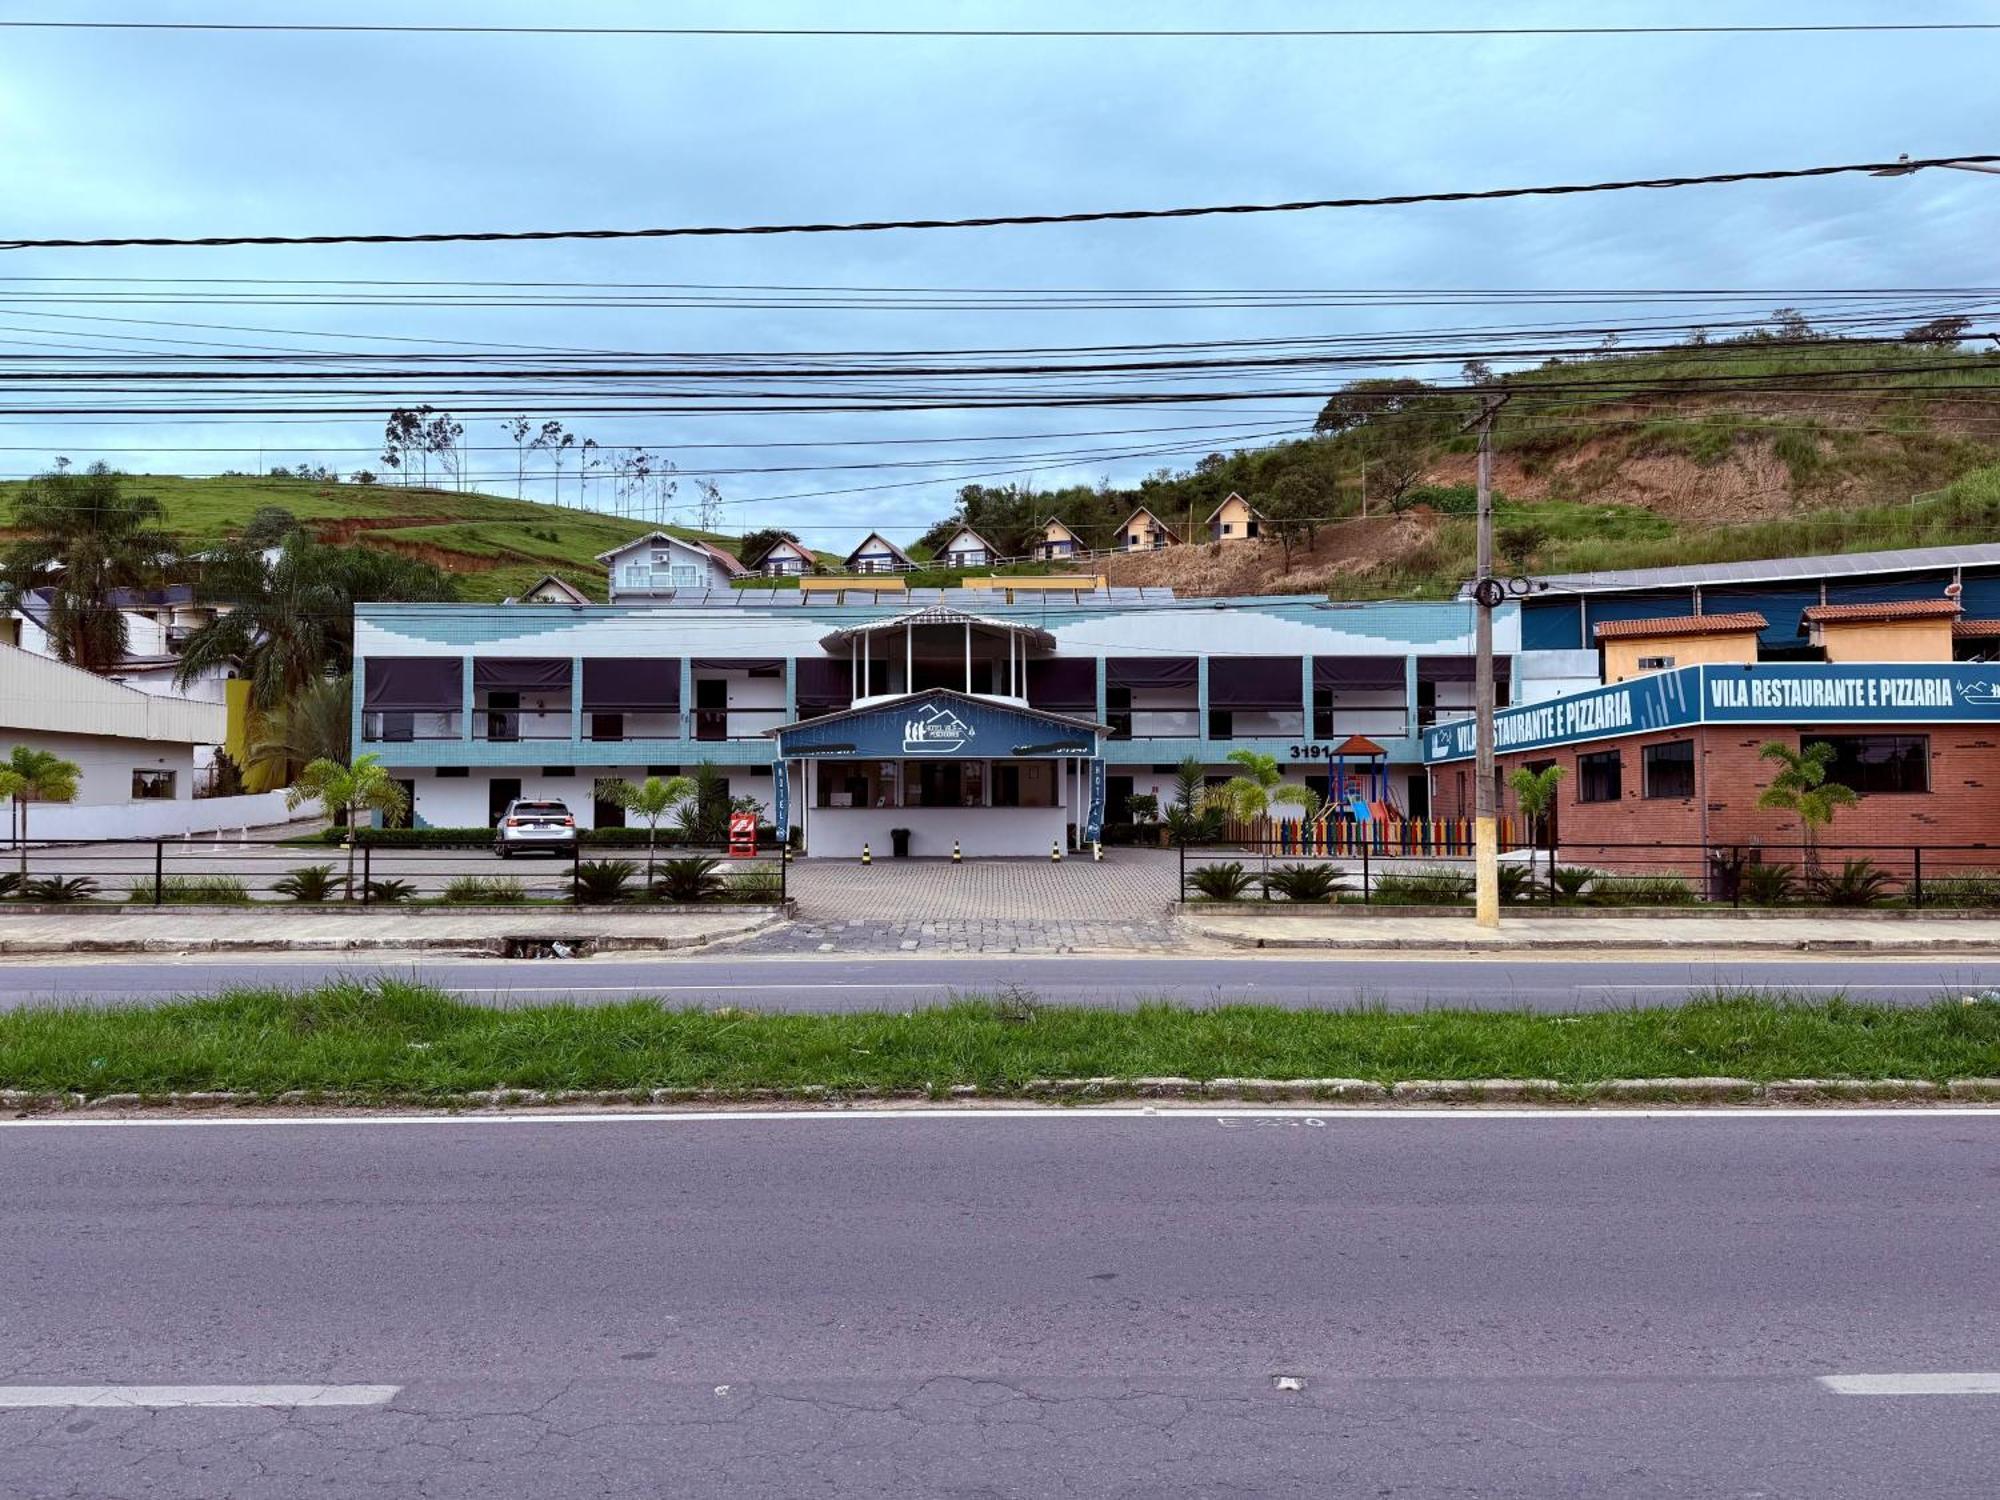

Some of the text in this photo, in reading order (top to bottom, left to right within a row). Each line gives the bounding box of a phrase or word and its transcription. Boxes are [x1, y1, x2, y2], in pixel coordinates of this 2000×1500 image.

[1711, 678, 1953, 707] VILA RESTAURANTE E PIZZARIA
[1493, 706, 1556, 748] STAURANTE
[1557, 704, 1564, 735] E
[1566, 690, 1633, 735] PIZZARIA
[1290, 744, 1330, 759] 3191
